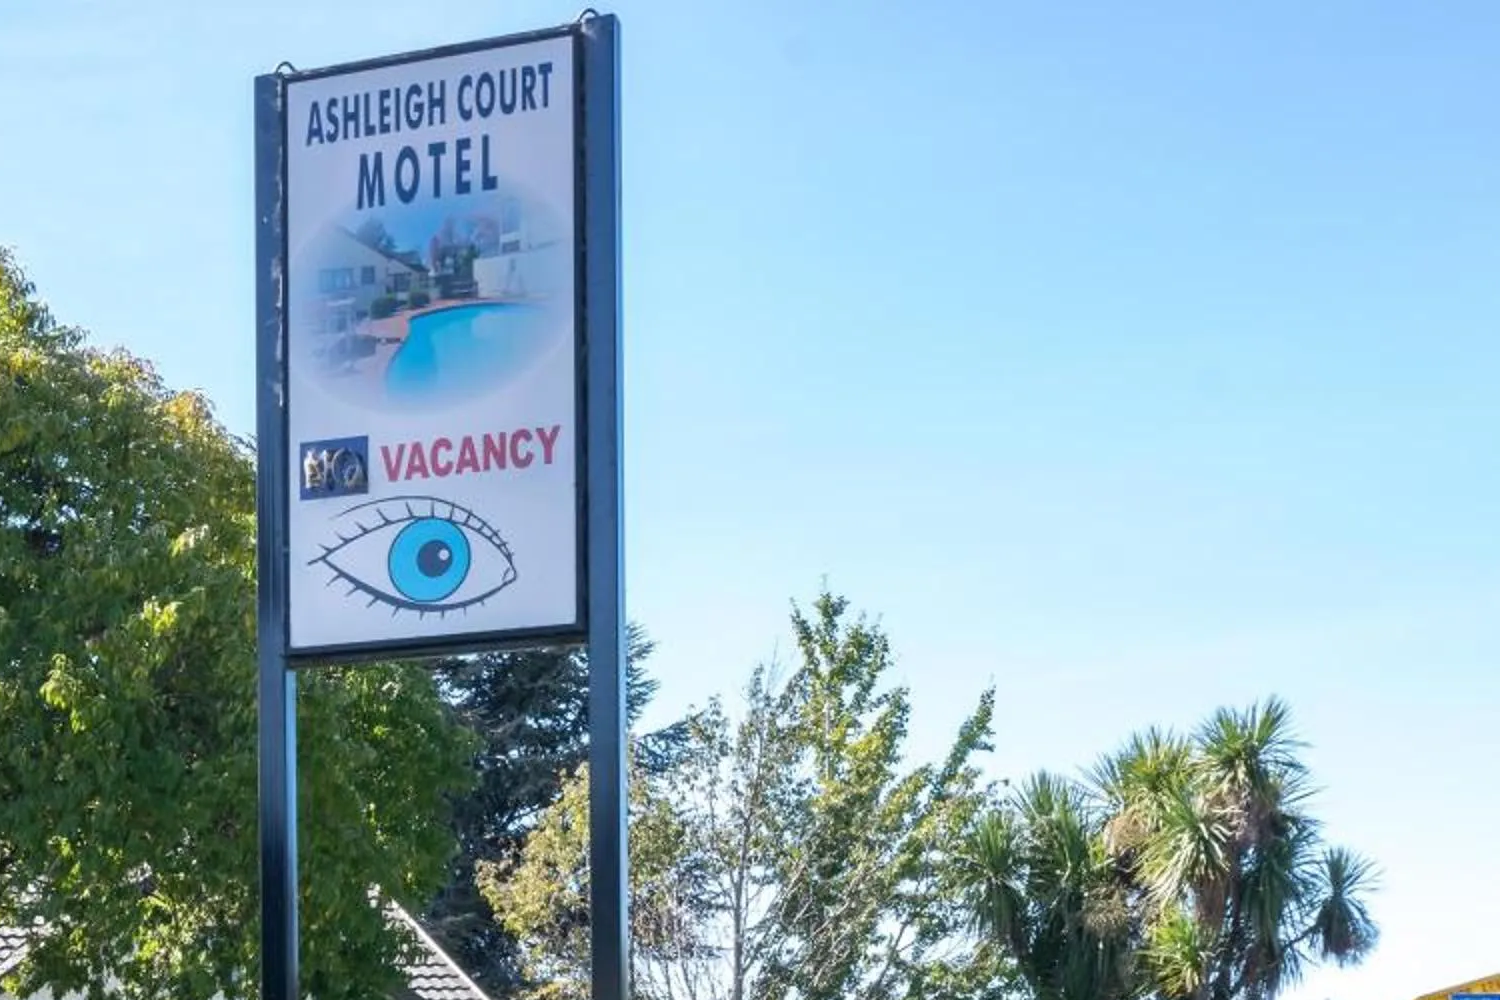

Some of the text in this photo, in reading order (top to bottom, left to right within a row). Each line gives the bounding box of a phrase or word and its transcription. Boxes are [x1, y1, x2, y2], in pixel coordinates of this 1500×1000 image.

[306, 61, 553, 146] ASHLEIGH COURT
[356, 134, 498, 210] MOTEL
[380, 425, 561, 483] VACANCY
